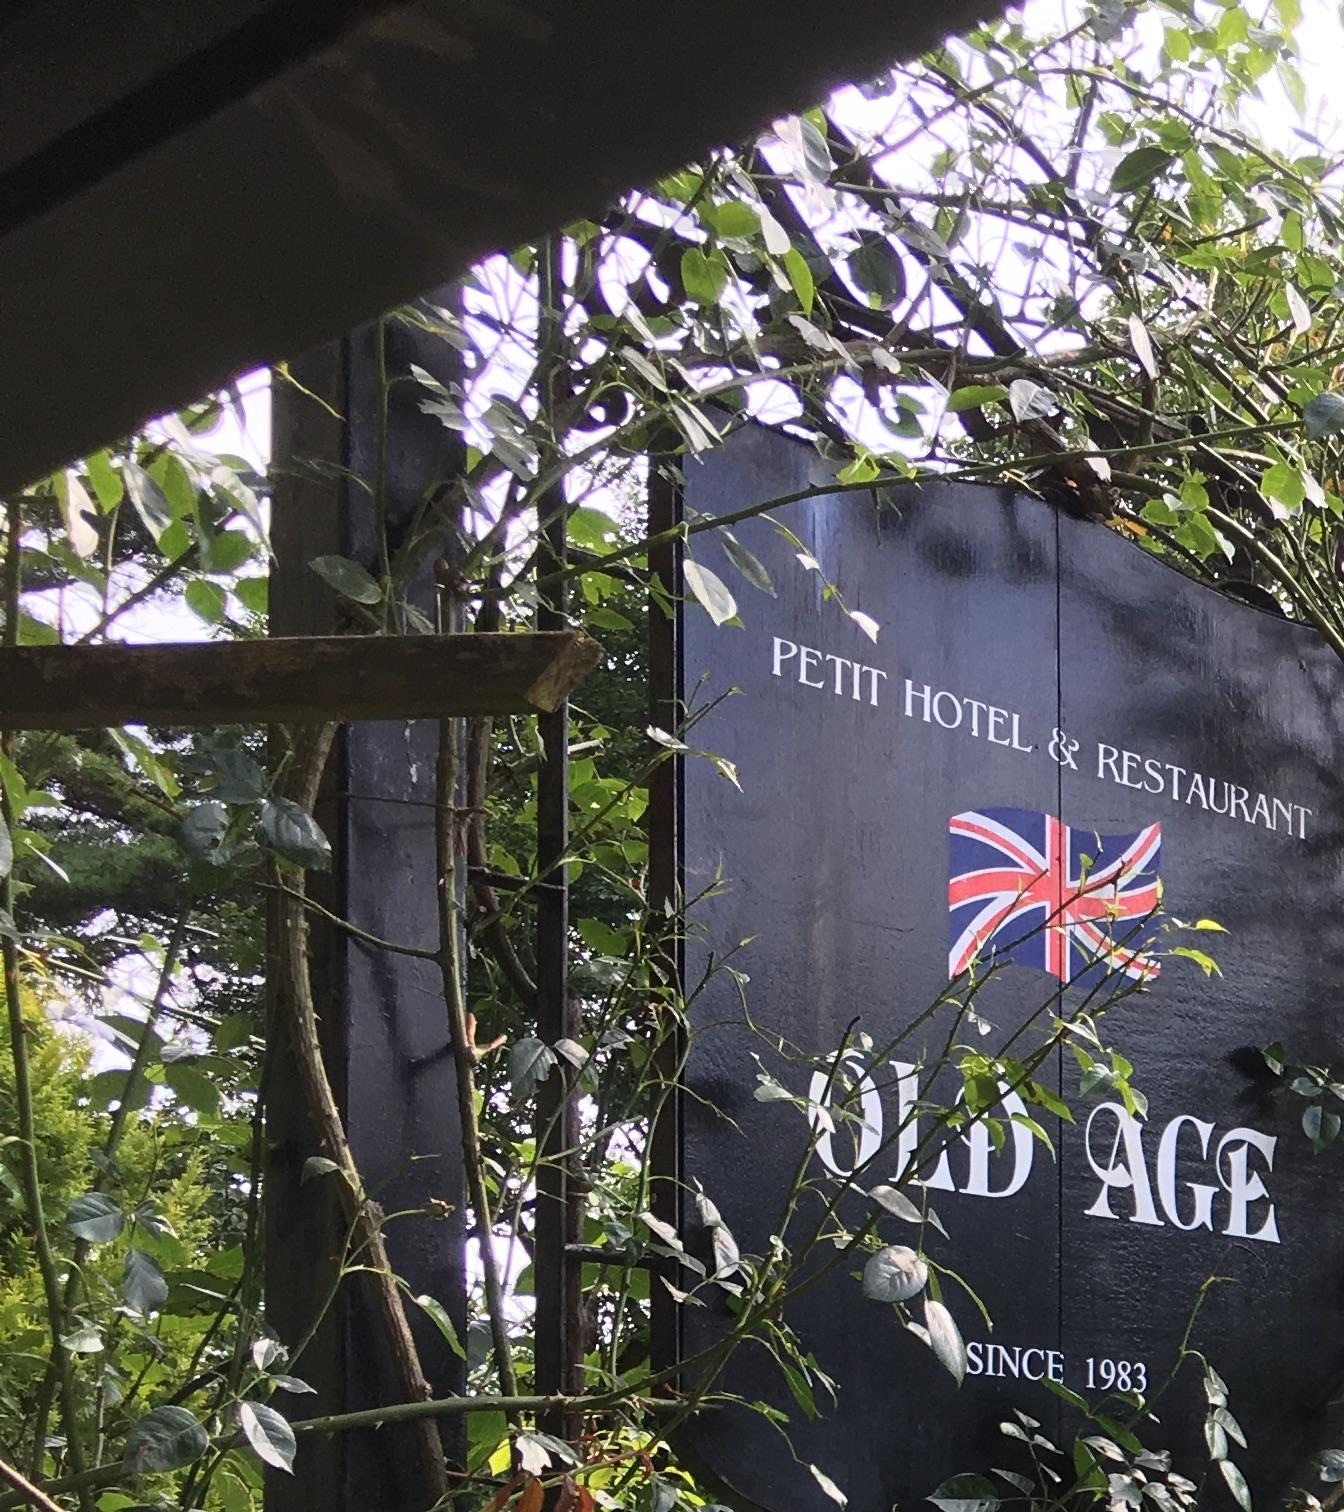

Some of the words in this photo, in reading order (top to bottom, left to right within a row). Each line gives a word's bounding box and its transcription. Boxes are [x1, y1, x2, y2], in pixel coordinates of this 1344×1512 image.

[771, 636, 888, 707] PETIT
[904, 679, 1033, 754] HOTEL
[1047, 727, 1080, 771] &
[1097, 742, 1313, 841] RESTAURANT
[808, 1049, 1034, 1198] OLD
[1083, 1101, 1282, 1244] AGE
[966, 1341, 1065, 1385] SINCE
[1085, 1357, 1148, 1394] 1983
